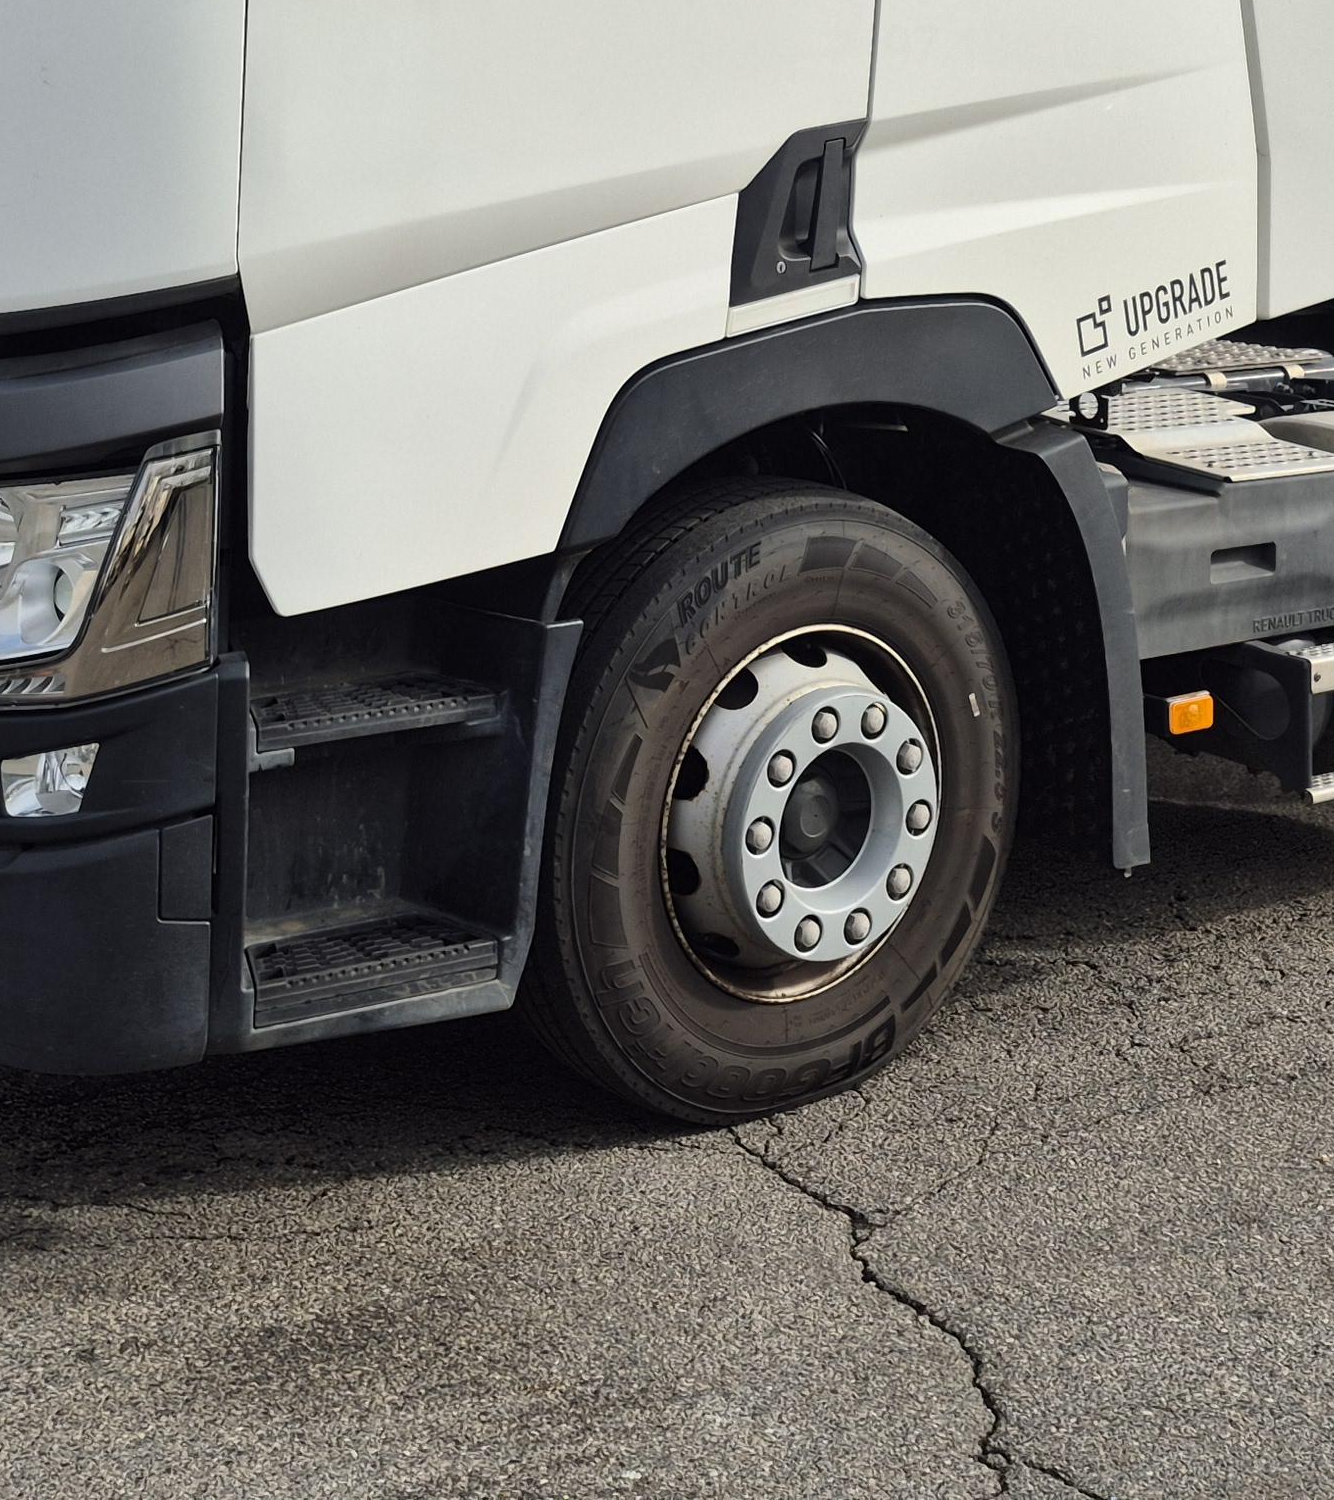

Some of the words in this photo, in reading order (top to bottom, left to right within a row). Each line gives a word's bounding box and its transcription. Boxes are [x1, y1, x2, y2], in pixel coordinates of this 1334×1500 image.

[1123, 259, 1231, 337] UPGRADE
[1082, 354, 1118, 380] NEW
[1128, 305, 1235, 361] GENERATION
[677, 541, 763, 628] ROUTE
[1252, 612, 1305, 633] RENAULT
